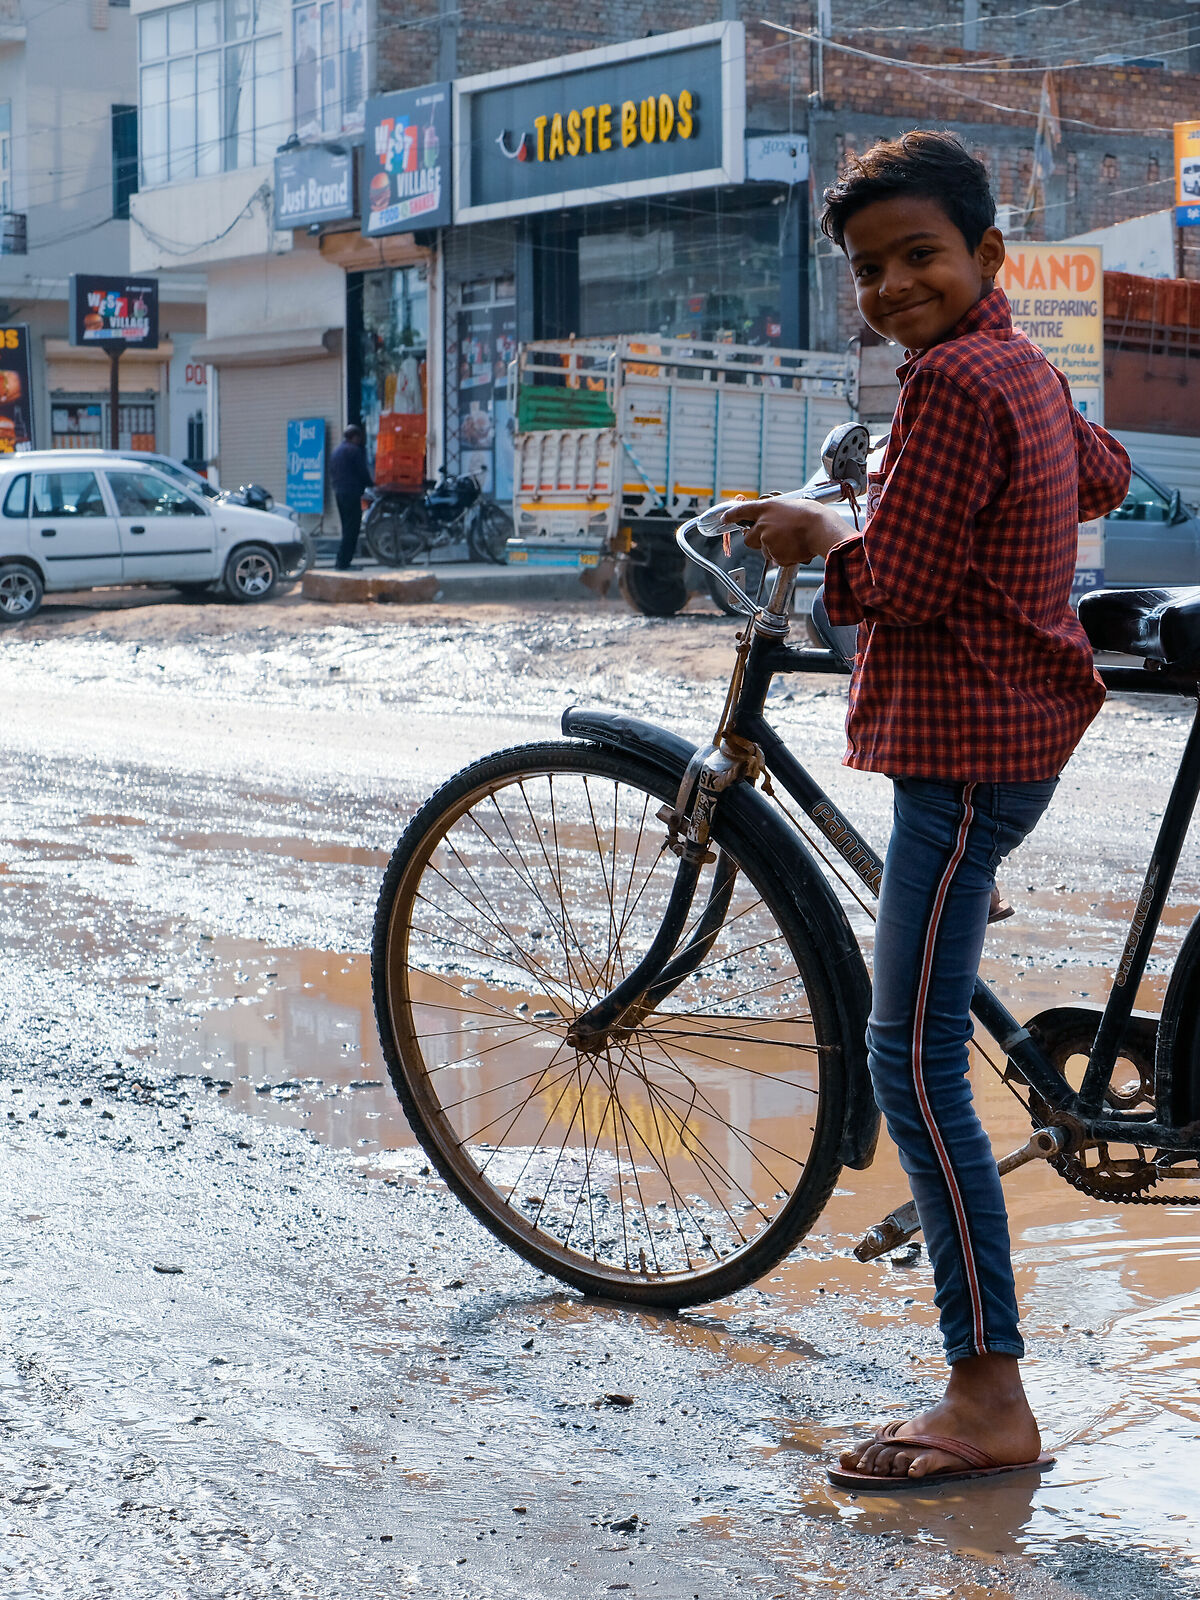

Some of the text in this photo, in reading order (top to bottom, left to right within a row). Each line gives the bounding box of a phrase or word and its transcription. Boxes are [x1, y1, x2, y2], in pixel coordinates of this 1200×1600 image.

[535, 89, 694, 162] TASTE BUDS
[280, 170, 348, 214] Just Brand
[397, 166, 441, 198] VILLAGE
[1004, 253, 1096, 292] NAND
[1034, 300, 1097, 317] REPARING
[109, 316, 149, 329] VILLAGE
[1062, 357, 1099, 368] Purchase
[700, 771, 719, 789] SK
